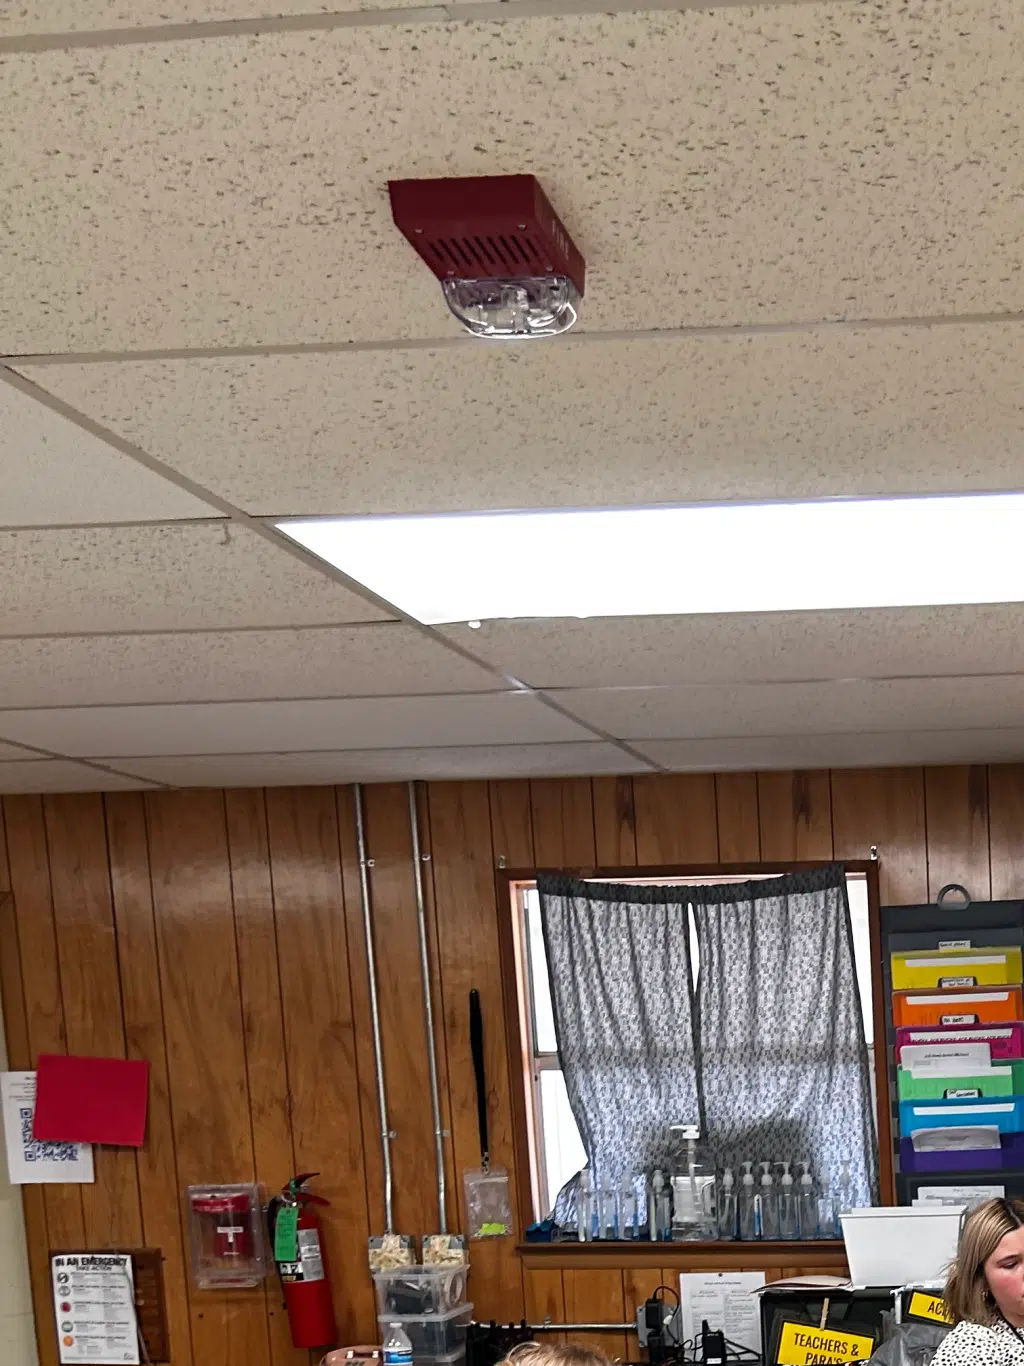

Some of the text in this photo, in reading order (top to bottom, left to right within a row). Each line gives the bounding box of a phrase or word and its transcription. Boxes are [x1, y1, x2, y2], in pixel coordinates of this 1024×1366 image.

[55, 1256, 128, 1267] IN AN EMERGENCY
[794, 1333, 859, 1357] TEACHERS &
